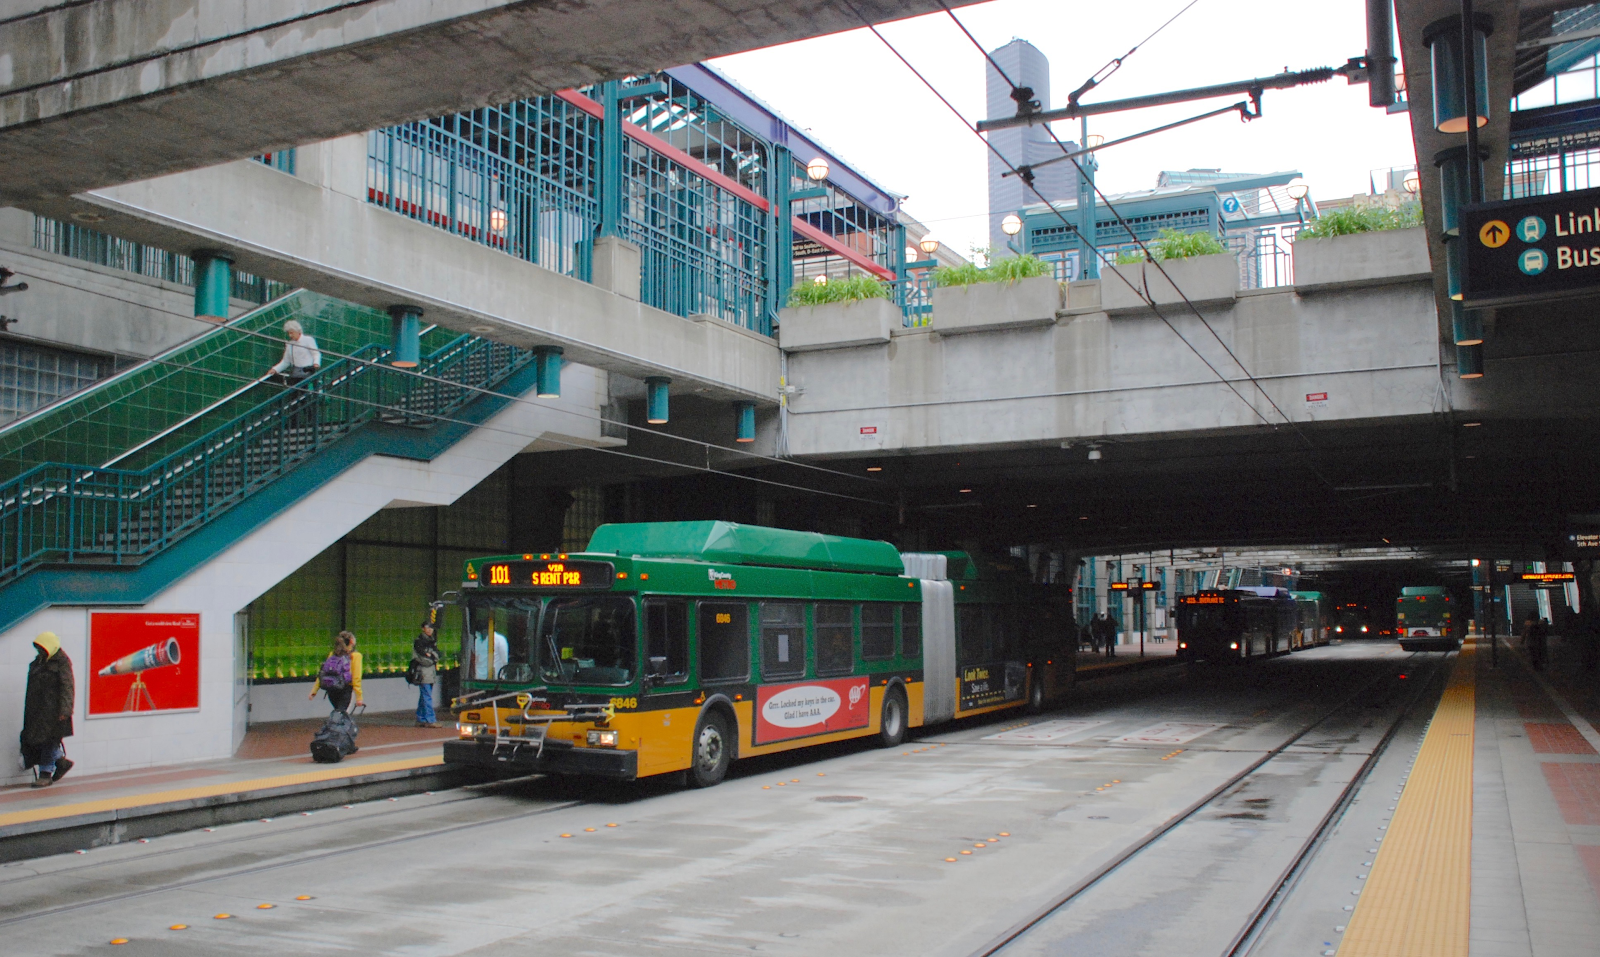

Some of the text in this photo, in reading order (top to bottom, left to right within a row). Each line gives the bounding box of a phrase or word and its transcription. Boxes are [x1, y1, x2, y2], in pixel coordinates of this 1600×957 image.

[547, 563, 564, 572] VIA
[490, 565, 510, 584] 101
[532, 572, 581, 585] S RENT P&R
[716, 613, 731, 624] 6846
[964, 668, 976, 682] Look
[609, 697, 638, 709] 6846
[768, 701, 780, 710] Grrr.
[780, 699, 797, 709] Locked
[797, 700, 804, 708] my
[805, 697, 815, 708] keys
[784, 711, 795, 720] Glad
[795, 711, 798, 719] I
[798, 710, 809, 718] have
